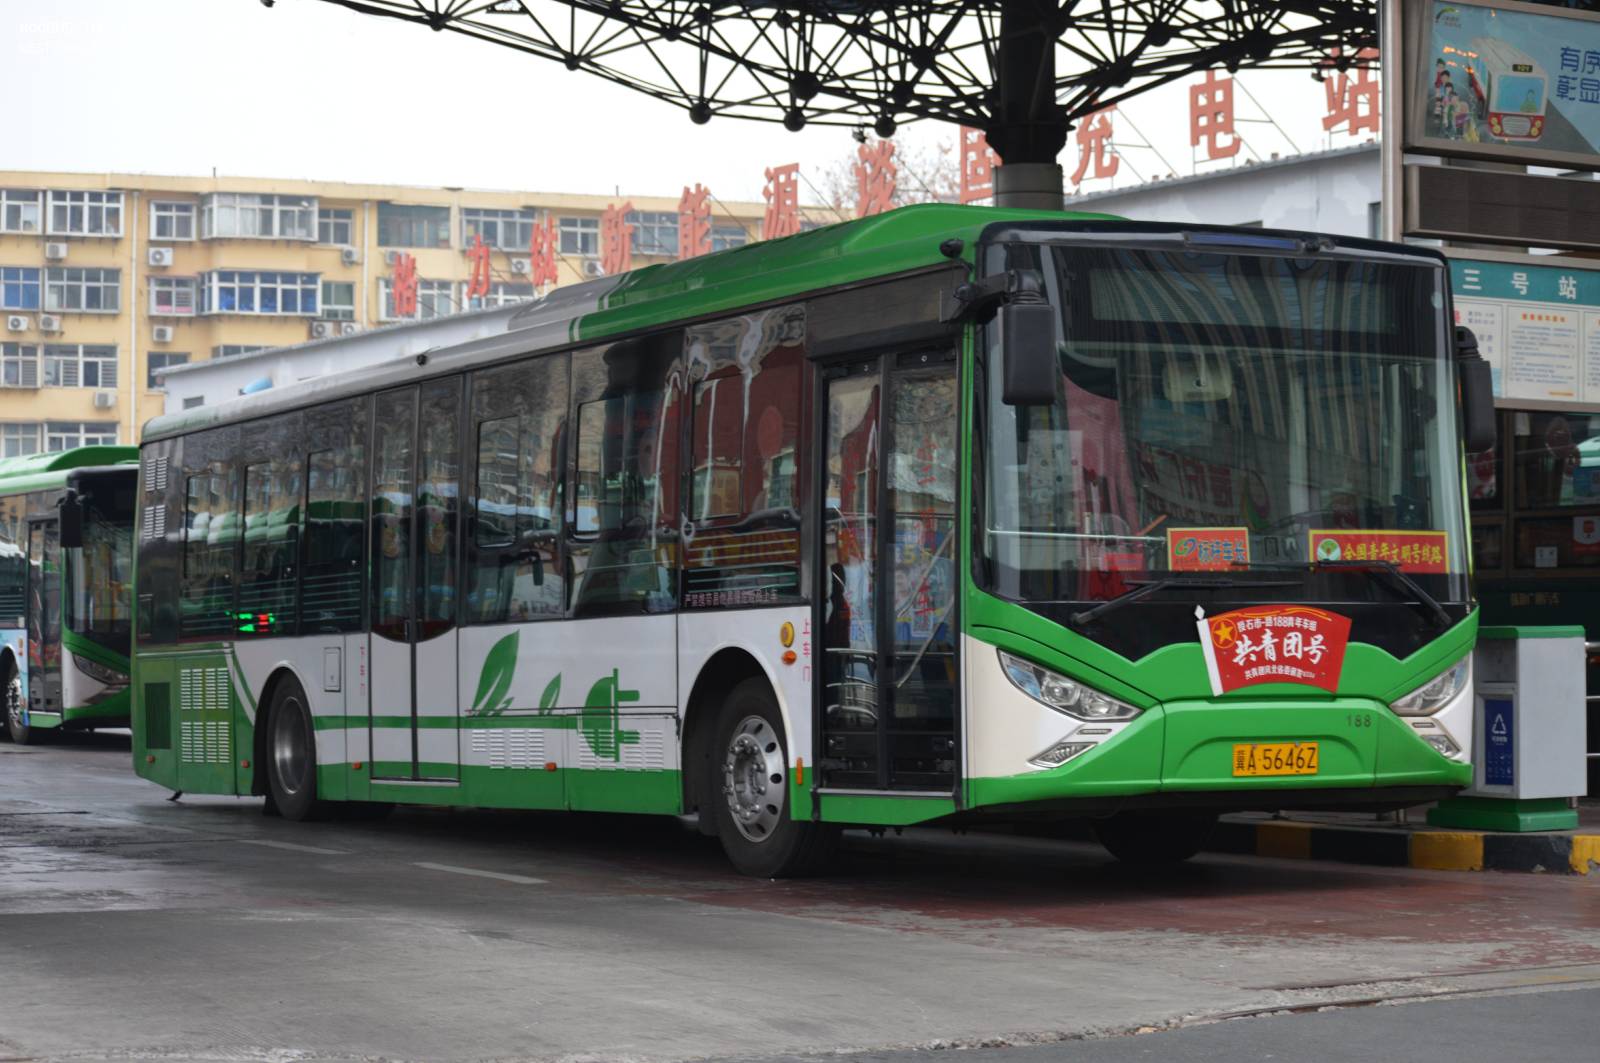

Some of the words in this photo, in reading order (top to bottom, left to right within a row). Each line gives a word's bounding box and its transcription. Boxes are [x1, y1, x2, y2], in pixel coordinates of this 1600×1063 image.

[1462, 269, 1577, 300] 三号站
[1232, 628, 1327, 666] 共青团号
[1347, 714, 1372, 727] 188
